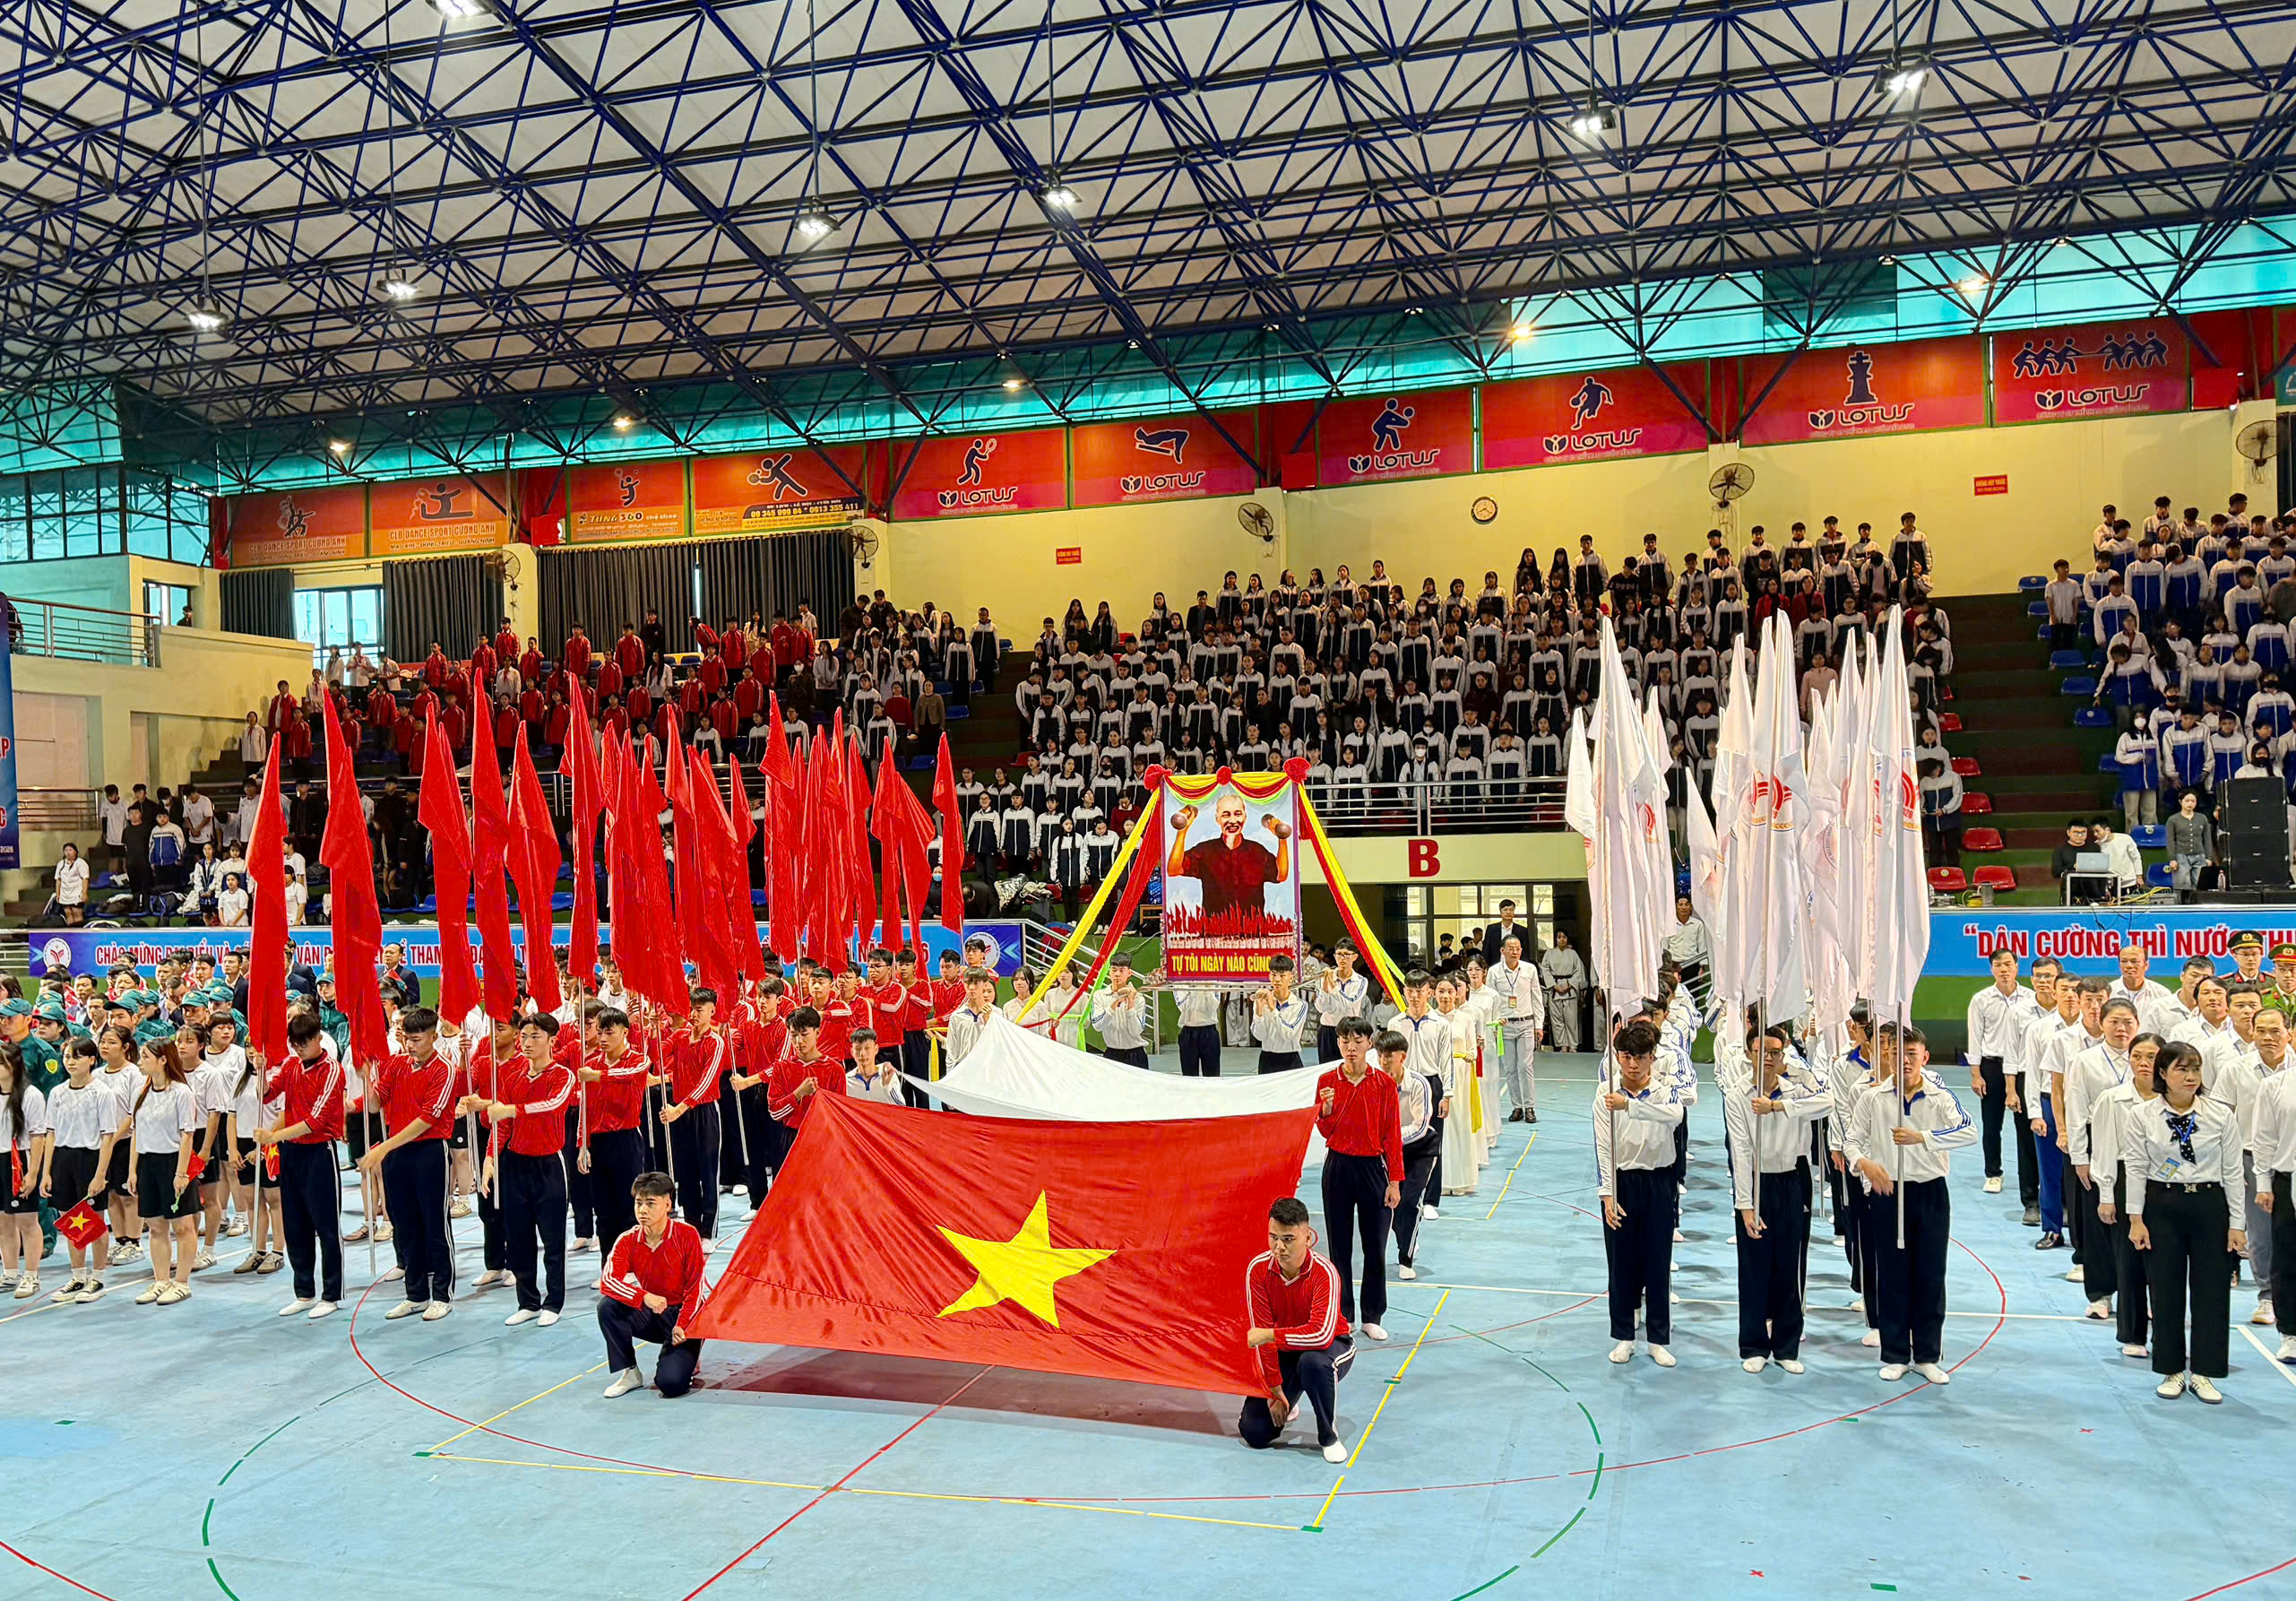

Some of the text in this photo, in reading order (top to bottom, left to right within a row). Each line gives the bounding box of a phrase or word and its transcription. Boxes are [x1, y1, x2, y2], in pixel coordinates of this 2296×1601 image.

[2067, 384, 2150, 406] LOTUS
[1839, 403, 1914, 426] LOTUS
[1571, 428, 1642, 451] LOTUS
[1375, 449, 1440, 470] LOTUS
[1144, 471, 1205, 490] LOTUS
[961, 487, 1018, 505] LOTUS
[619, 511, 643, 522] 360
[762, 509, 775, 517] 345
[809, 506, 828, 514] 0913
[845, 503, 859, 511] 411
[390, 531, 402, 541] CLB
[405, 528, 427, 540] DANCE
[430, 526, 453, 538] SPORT
[480, 523, 496, 534] ANH
[1408, 839, 1441, 878] B
[2036, 923, 2120, 957] CƯỜNG
[2128, 924, 2167, 957] THÌ
[1172, 954, 1184, 975] TỰ
[1185, 952, 1198, 973] TÔI
[1200, 952, 1224, 973] NGÀY
[1227, 952, 1245, 973] NÀO
